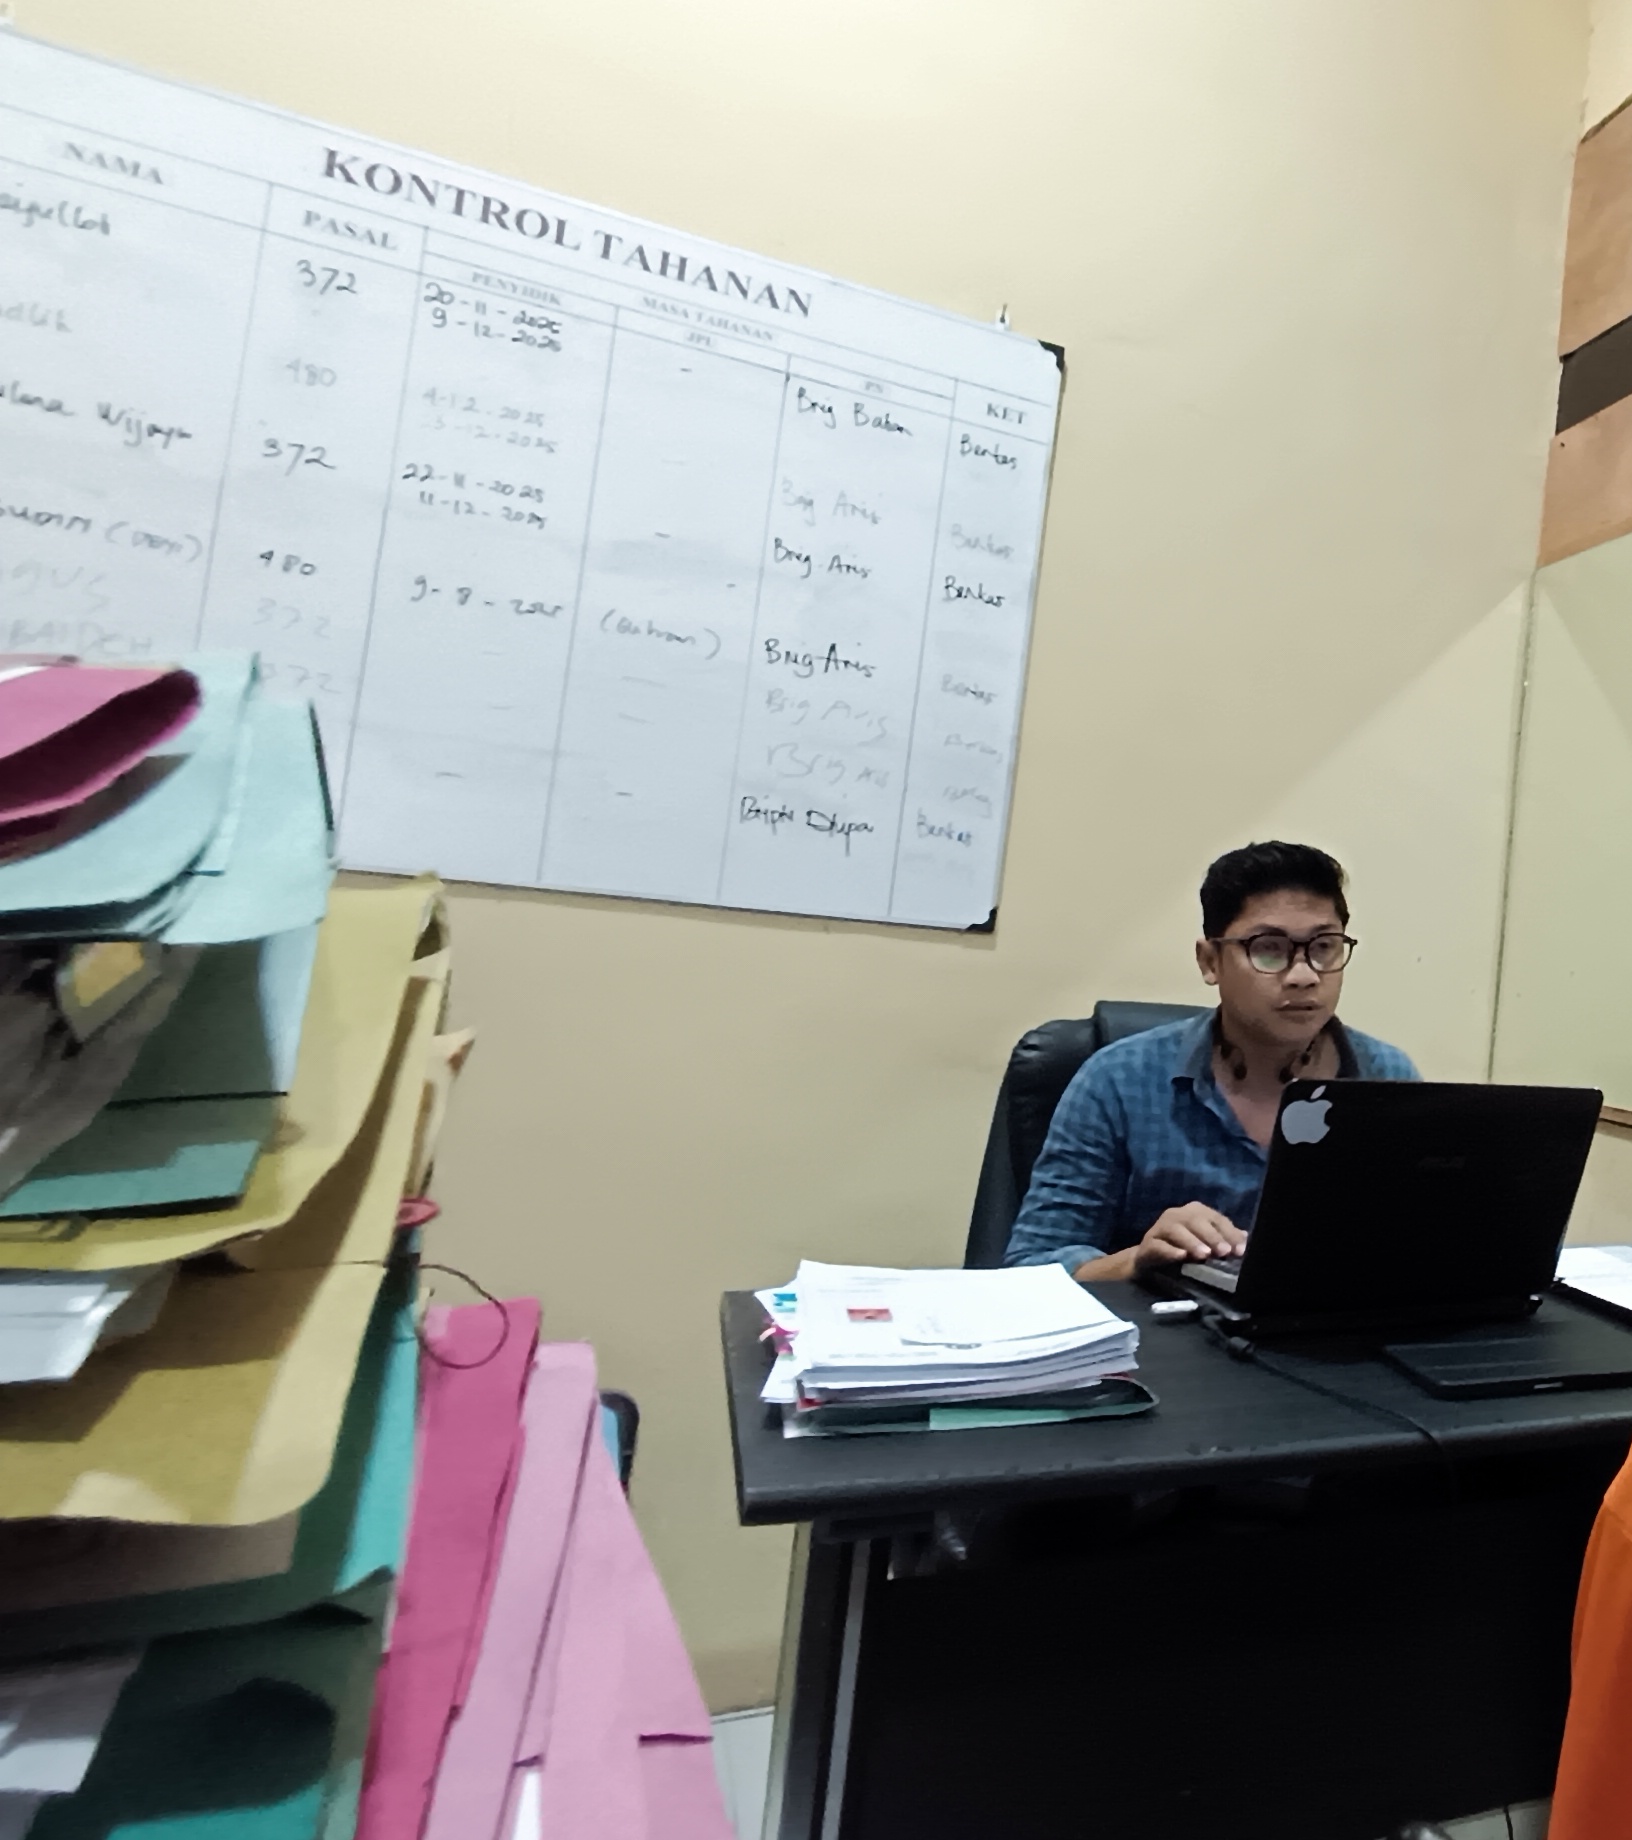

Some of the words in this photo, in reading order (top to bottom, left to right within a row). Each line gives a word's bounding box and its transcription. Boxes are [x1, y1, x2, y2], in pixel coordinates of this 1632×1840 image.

[63, 141, 165, 186] NAMA
[303, 208, 399, 251] PASAL
[321, 146, 580, 252] KONTROL
[594, 230, 813, 318] TAHANAN
[296, 259, 358, 296] 372
[471, 271, 562, 307] PENYIDIK
[642, 295, 690, 320] MASA
[696, 311, 774, 342] TAHANAN
[285, 356, 337, 388] 480
[986, 403, 1027, 426] KET
[262, 437, 337, 475] 372
[259, 549, 316, 576] 480
[252, 597, 331, 640] 372
